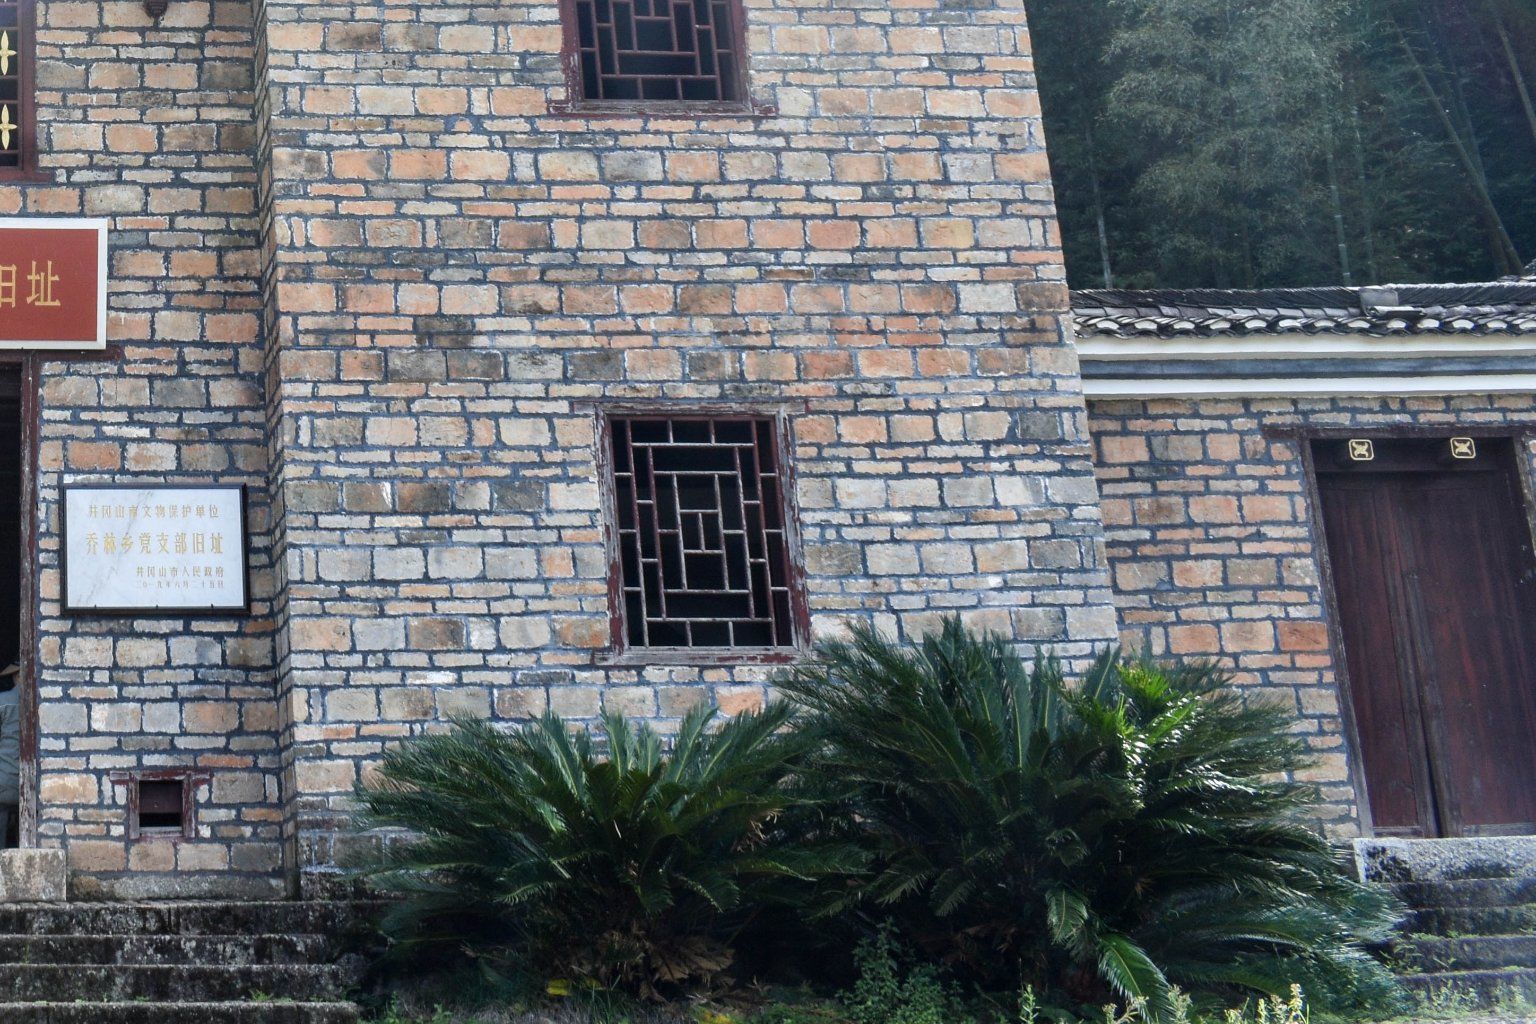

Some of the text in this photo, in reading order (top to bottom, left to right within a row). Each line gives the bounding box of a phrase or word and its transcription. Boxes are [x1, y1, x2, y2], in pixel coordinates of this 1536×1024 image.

[88, 504, 219, 518] 井冈山市文物保护单位
[85, 532, 224, 555] 乔林乡党支部旧址
[136, 566, 224, 577] 井冈山市人民政府
